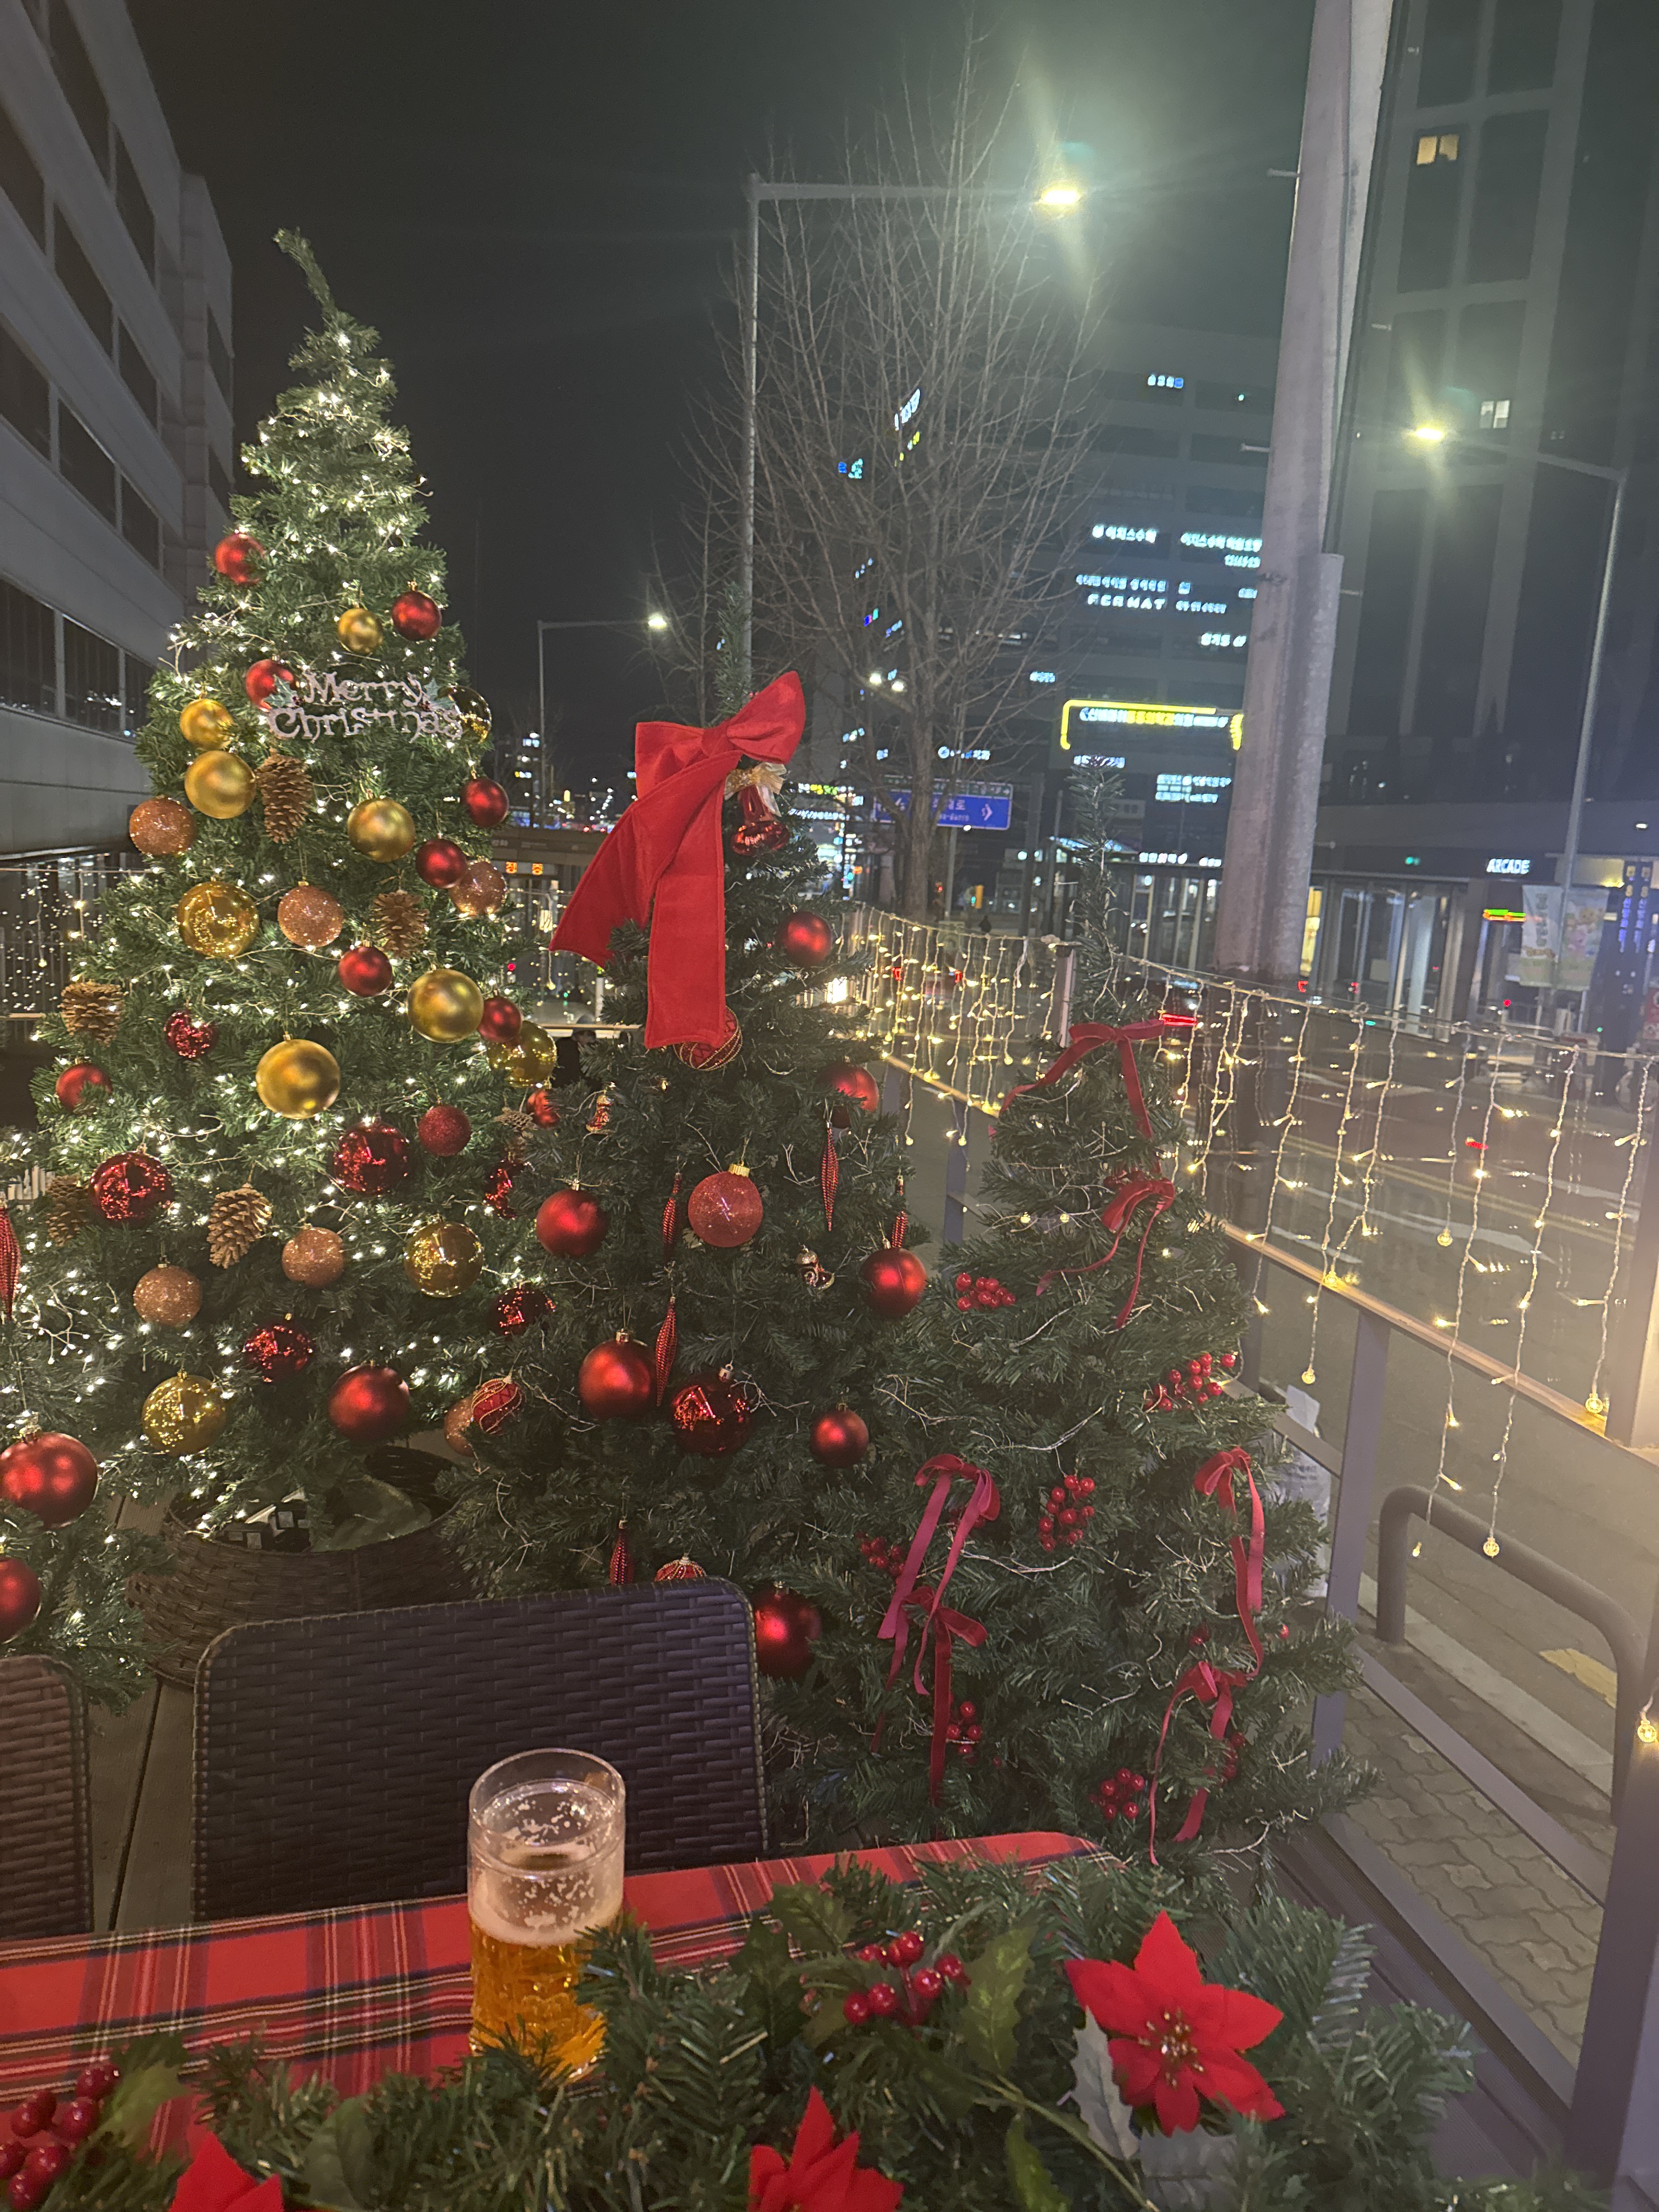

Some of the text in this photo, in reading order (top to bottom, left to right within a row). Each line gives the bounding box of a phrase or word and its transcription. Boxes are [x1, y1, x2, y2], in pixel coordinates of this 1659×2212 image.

[1088, 594, 1165, 610] FERMAT
[303, 670, 428, 708] Merry
[267, 706, 464, 744] Christmas
[1486, 858, 1531, 874] ARCADE
